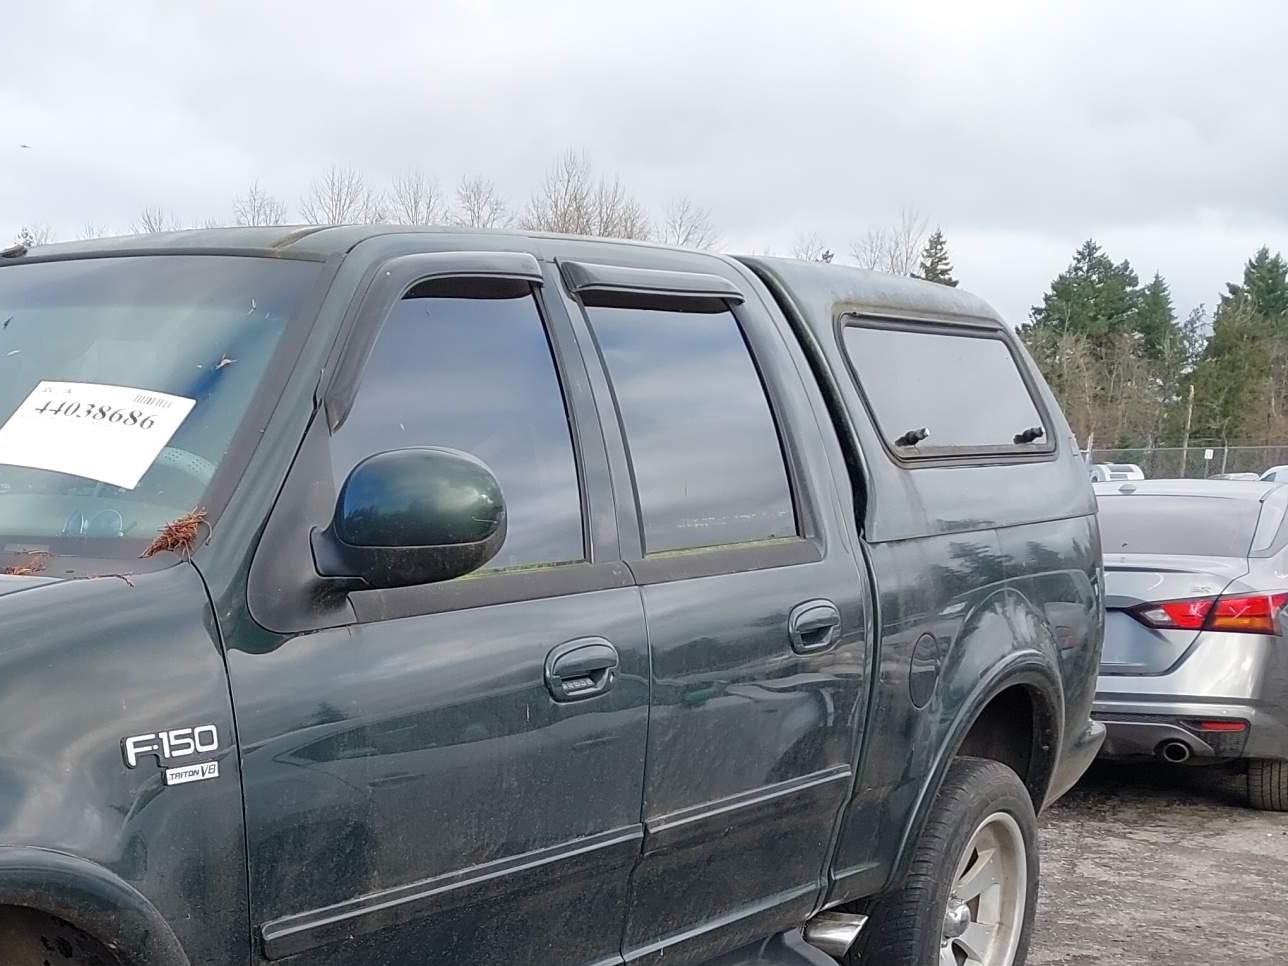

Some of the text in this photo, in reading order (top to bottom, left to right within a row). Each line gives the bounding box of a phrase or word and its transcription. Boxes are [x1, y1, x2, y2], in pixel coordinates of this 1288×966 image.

[35, 400, 156, 430] 44038686
[125, 724, 219, 767] F-150
[169, 764, 217, 781] TRITON V8
